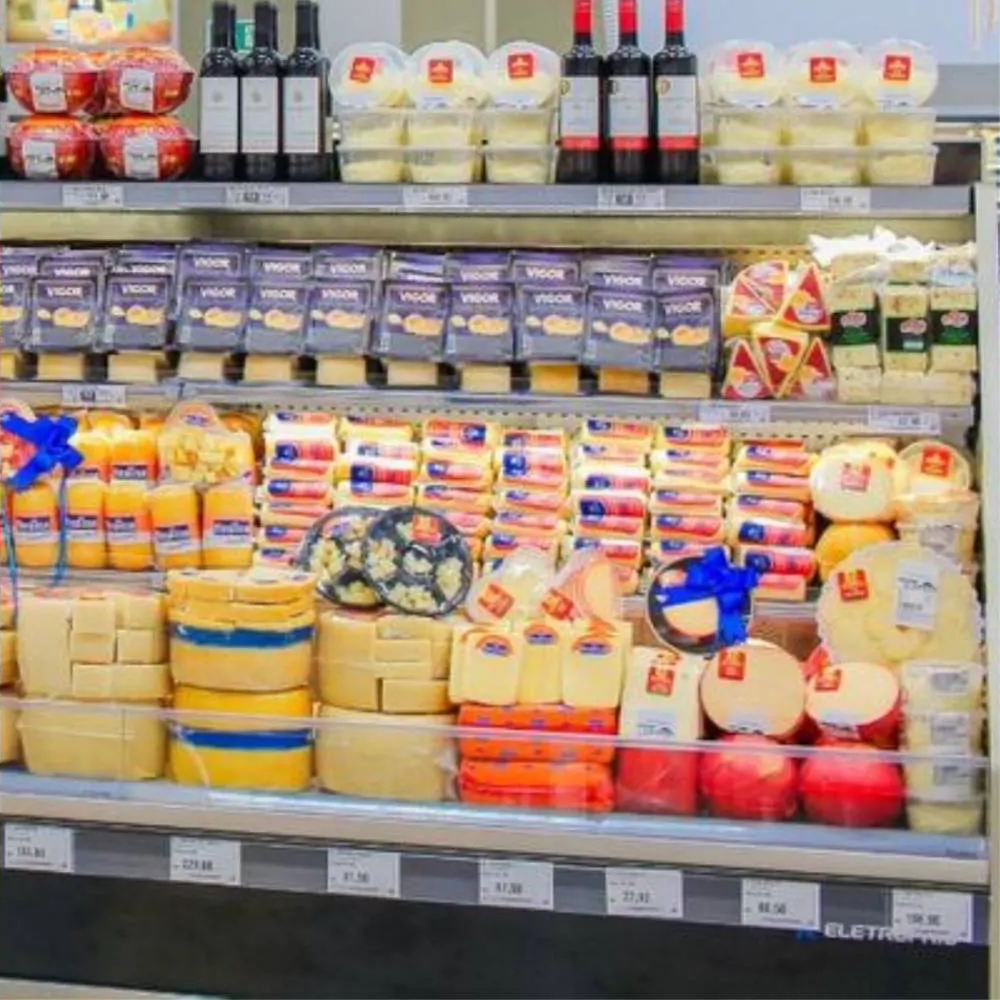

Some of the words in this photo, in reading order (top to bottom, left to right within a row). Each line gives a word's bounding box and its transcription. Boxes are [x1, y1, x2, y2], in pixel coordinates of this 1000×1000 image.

[195, 257, 230, 268] VIGOR
[264, 262, 299, 274] VIGOR
[331, 263, 366, 274] VIGOR
[526, 266, 565, 280] VIGOR
[603, 274, 643, 286] VIGOR
[667, 274, 706, 286] VIGOR
[47, 286, 83, 297] VIGOR
[122, 284, 157, 295] VIGOR
[202, 287, 236, 298] VIGOR
[261, 288, 296, 300] VIGOR
[322, 288, 359, 300] VIGOR
[400, 292, 437, 303] VIGOR
[461, 292, 499, 303] VIGOR
[534, 293, 573, 304] VIGOR
[603, 299, 643, 312] VIGOR
[663, 301, 702, 315] VIGOR
